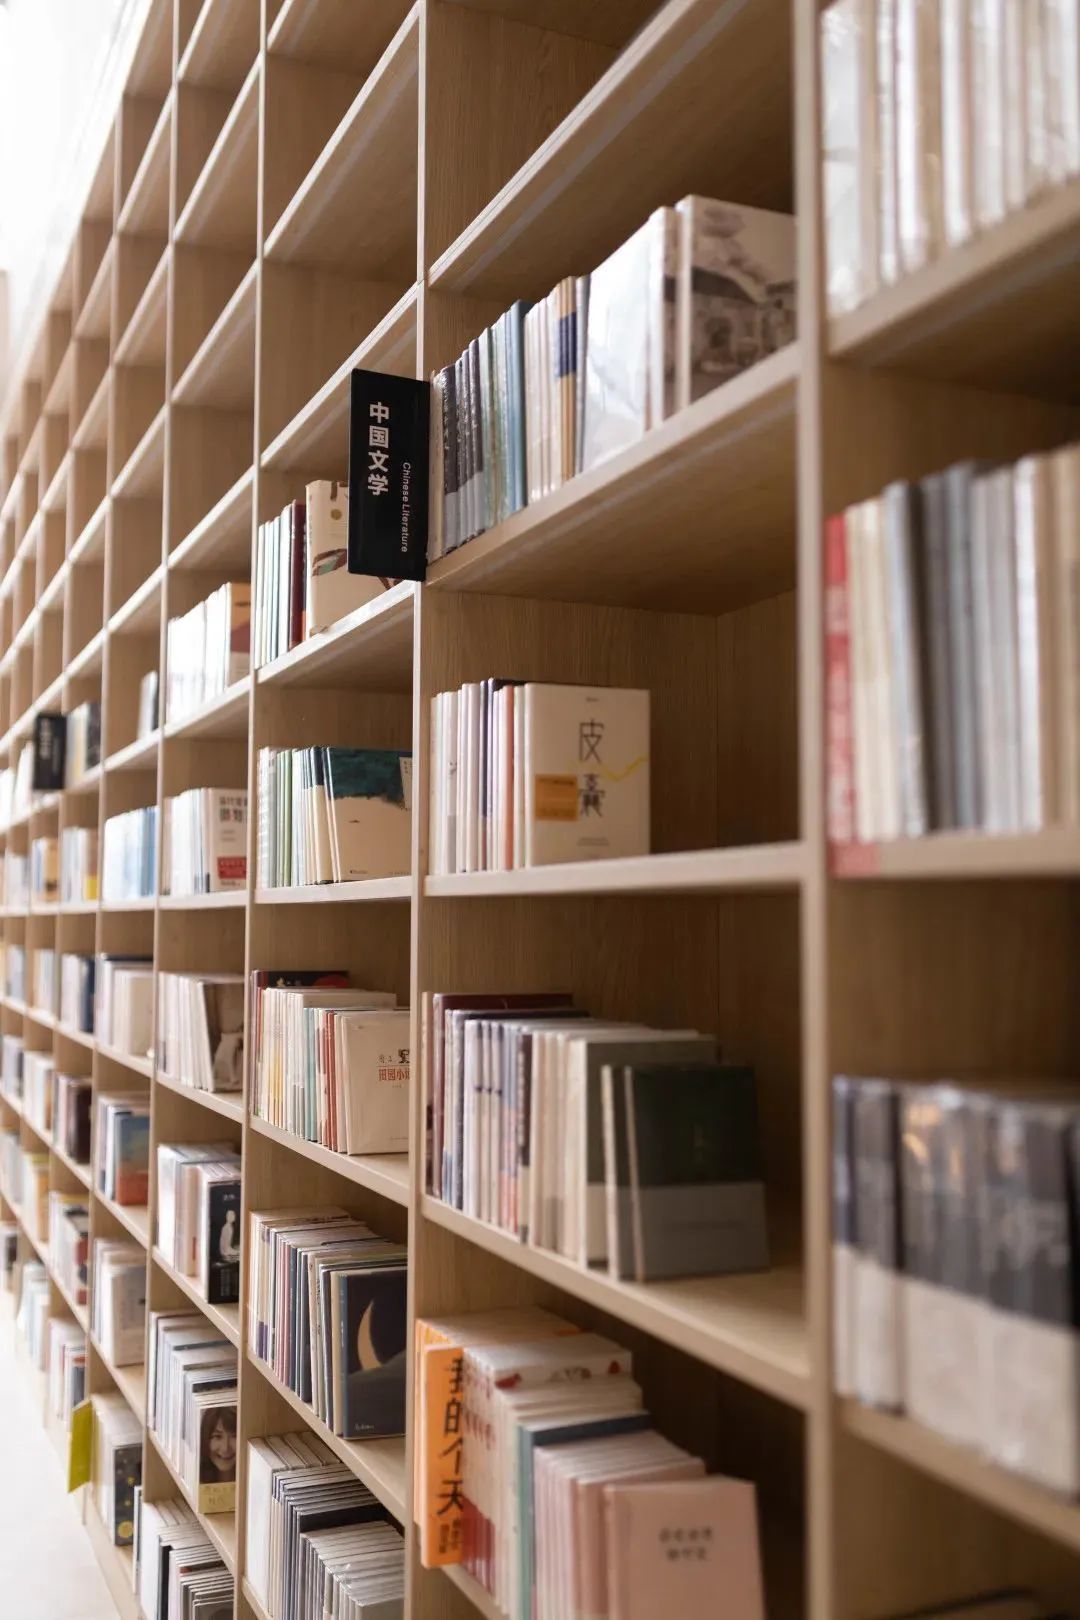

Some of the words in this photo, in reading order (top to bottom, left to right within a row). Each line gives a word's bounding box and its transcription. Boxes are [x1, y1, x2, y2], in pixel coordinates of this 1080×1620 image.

[367, 401, 390, 496] 中国文学
[401, 462, 412, 502] Chinese
[401, 502, 411, 553] Literature
